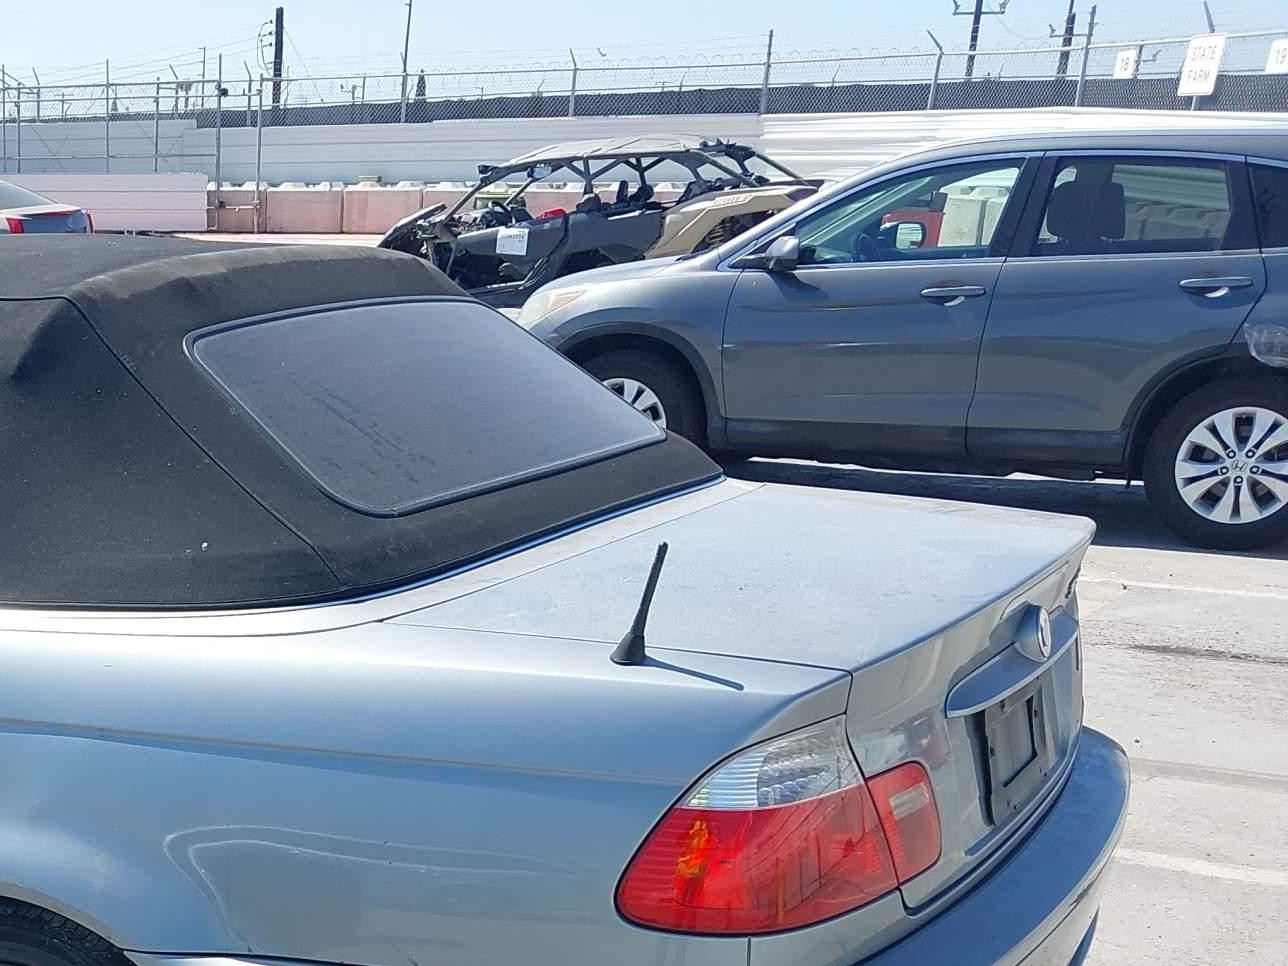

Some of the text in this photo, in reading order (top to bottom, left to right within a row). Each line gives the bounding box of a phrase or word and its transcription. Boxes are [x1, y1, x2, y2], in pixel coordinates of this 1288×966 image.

[1190, 44, 1218, 63] STATE
[1274, 47, 1288, 64] 19
[1120, 56, 1130, 72] 18
[1187, 69, 1212, 82] FARM
